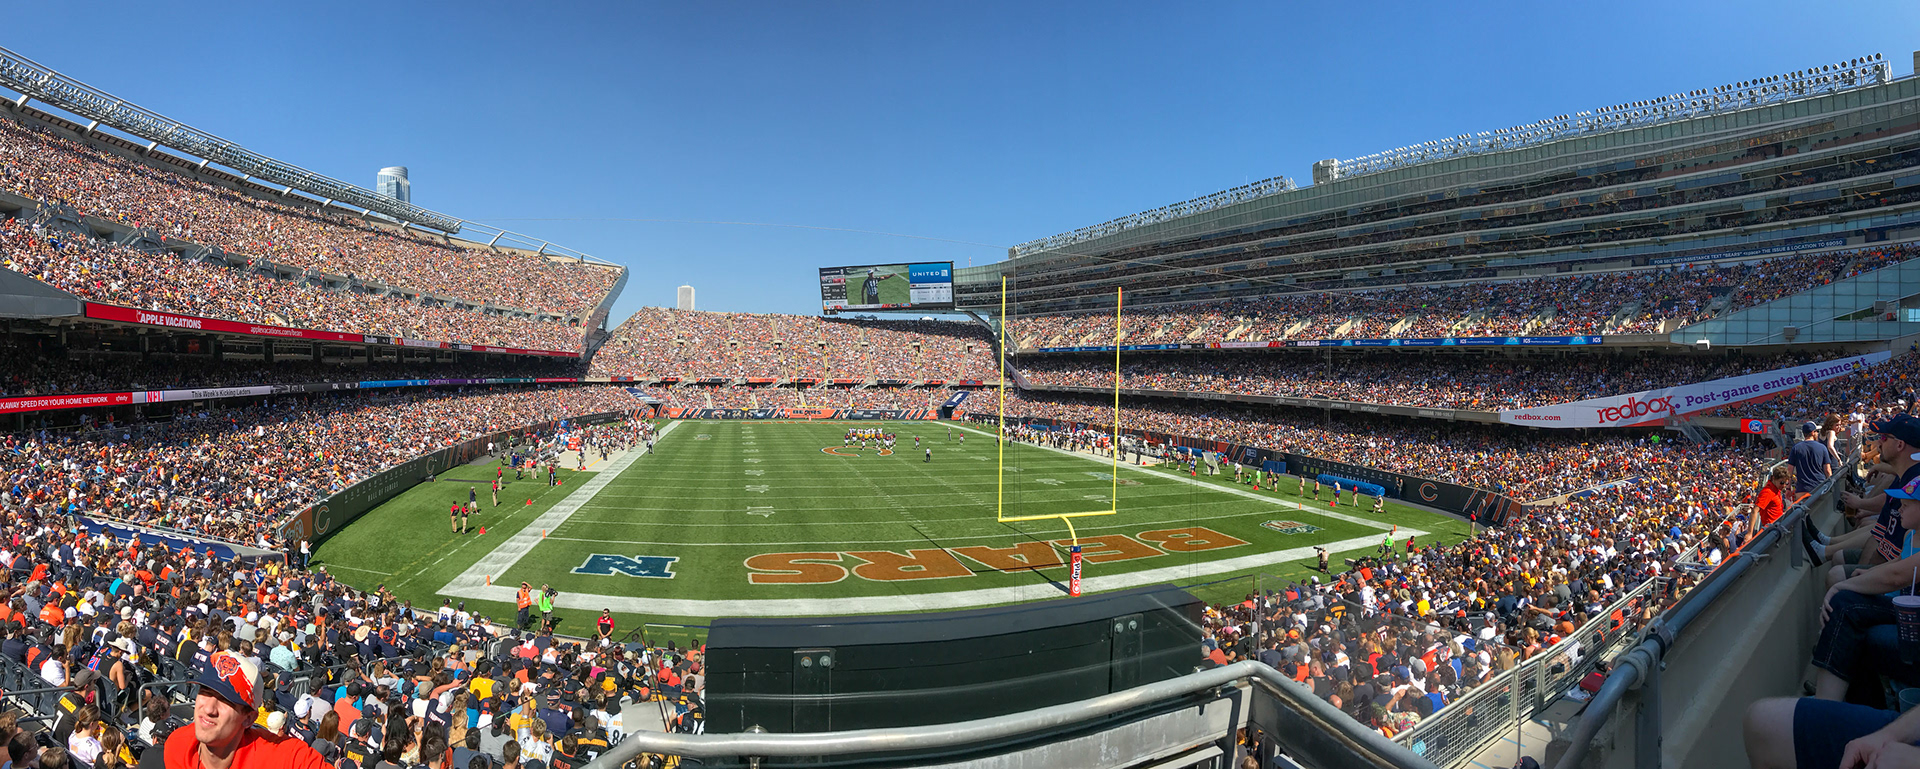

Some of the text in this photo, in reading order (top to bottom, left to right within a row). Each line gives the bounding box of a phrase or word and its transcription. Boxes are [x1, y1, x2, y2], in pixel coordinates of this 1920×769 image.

[1791, 242, 1817, 250] LOCATION
[140, 313, 165, 325] APPLE
[165, 316, 202, 330] VACATIONS
[191, 390, 202, 399] This
[1685, 382, 1760, 407] Post-game
[20, 400, 37, 409] SPEED
[48, 398, 65, 406] YOUR
[65, 397, 82, 405] HOME
[82, 396, 108, 404] NETWORK
[1514, 413, 1561, 421] redbox.com
[743, 526, 1252, 585] BEARS
